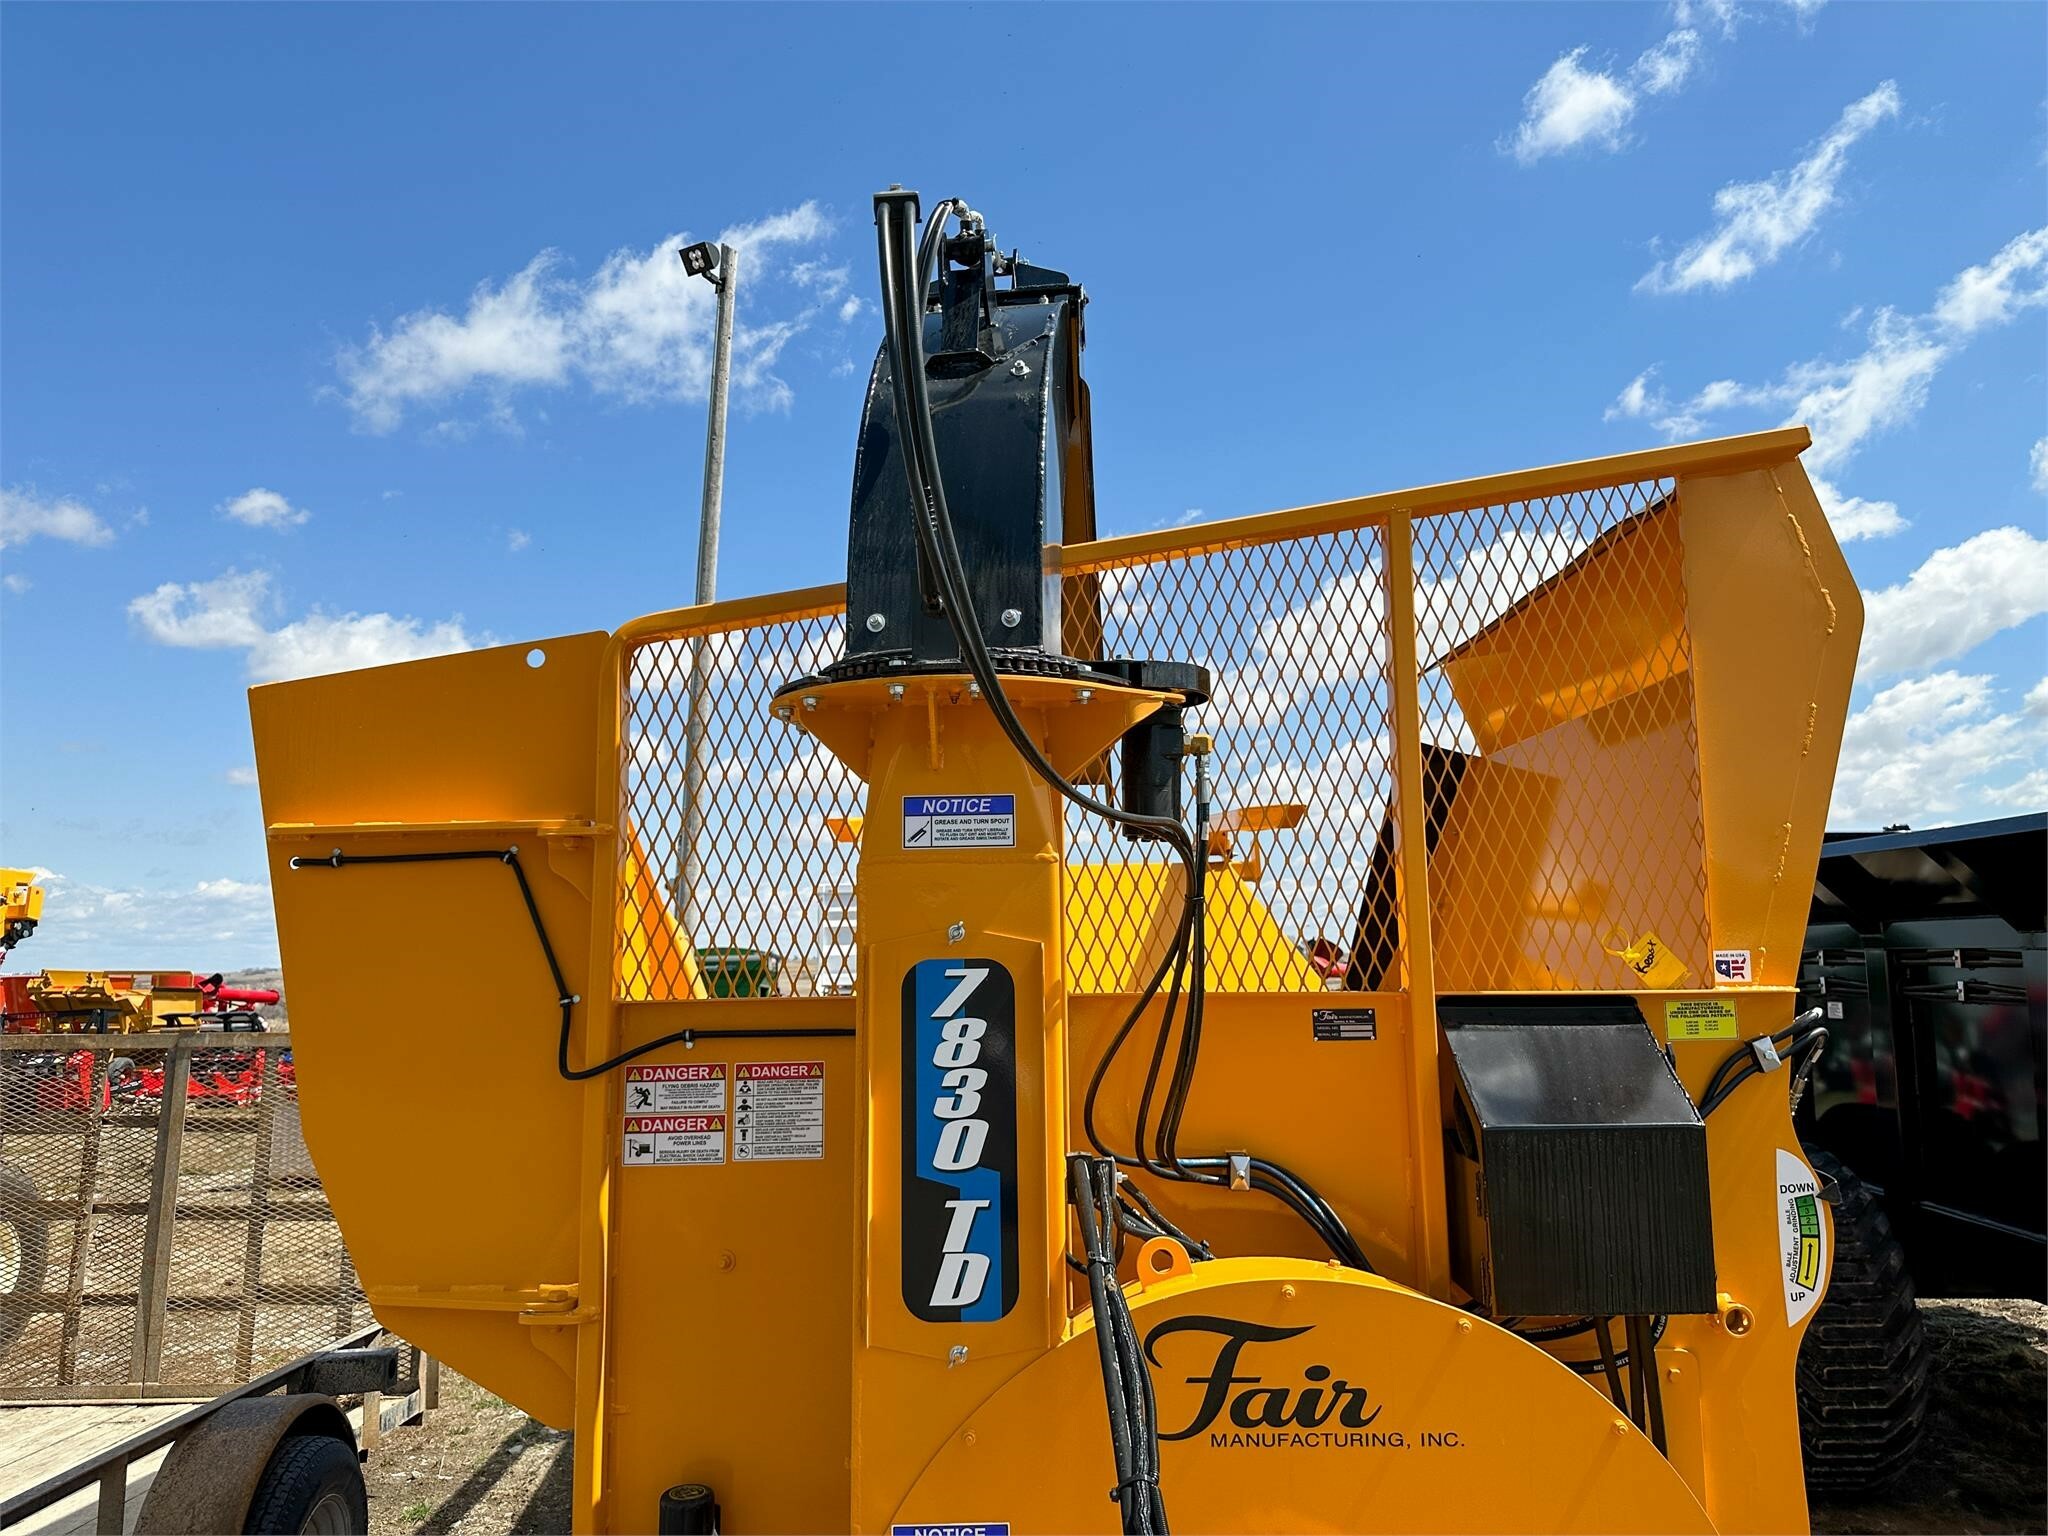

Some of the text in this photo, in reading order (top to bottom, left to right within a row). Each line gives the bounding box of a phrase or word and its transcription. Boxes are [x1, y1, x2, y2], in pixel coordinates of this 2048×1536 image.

[923, 798, 991, 813] NOTICE
[1319, 1010, 1338, 1021] Fair
[643, 1067, 709, 1081] DANGER
[752, 1065, 808, 1077] DANGER
[930, 968, 990, 1171] 7830
[641, 1118, 708, 1132] DANGER
[1780, 1182, 1815, 1194] DOWN
[1788, 1198, 1799, 1233] GRINDING
[929, 1200, 990, 1307] TD
[1789, 1236, 1800, 1283] ADJUSTMENT
[1790, 1291, 1806, 1302] UP
[1143, 1315, 1383, 1441] Fair
[1210, 1432, 1465, 1449] MANUFACTURING, INC.
